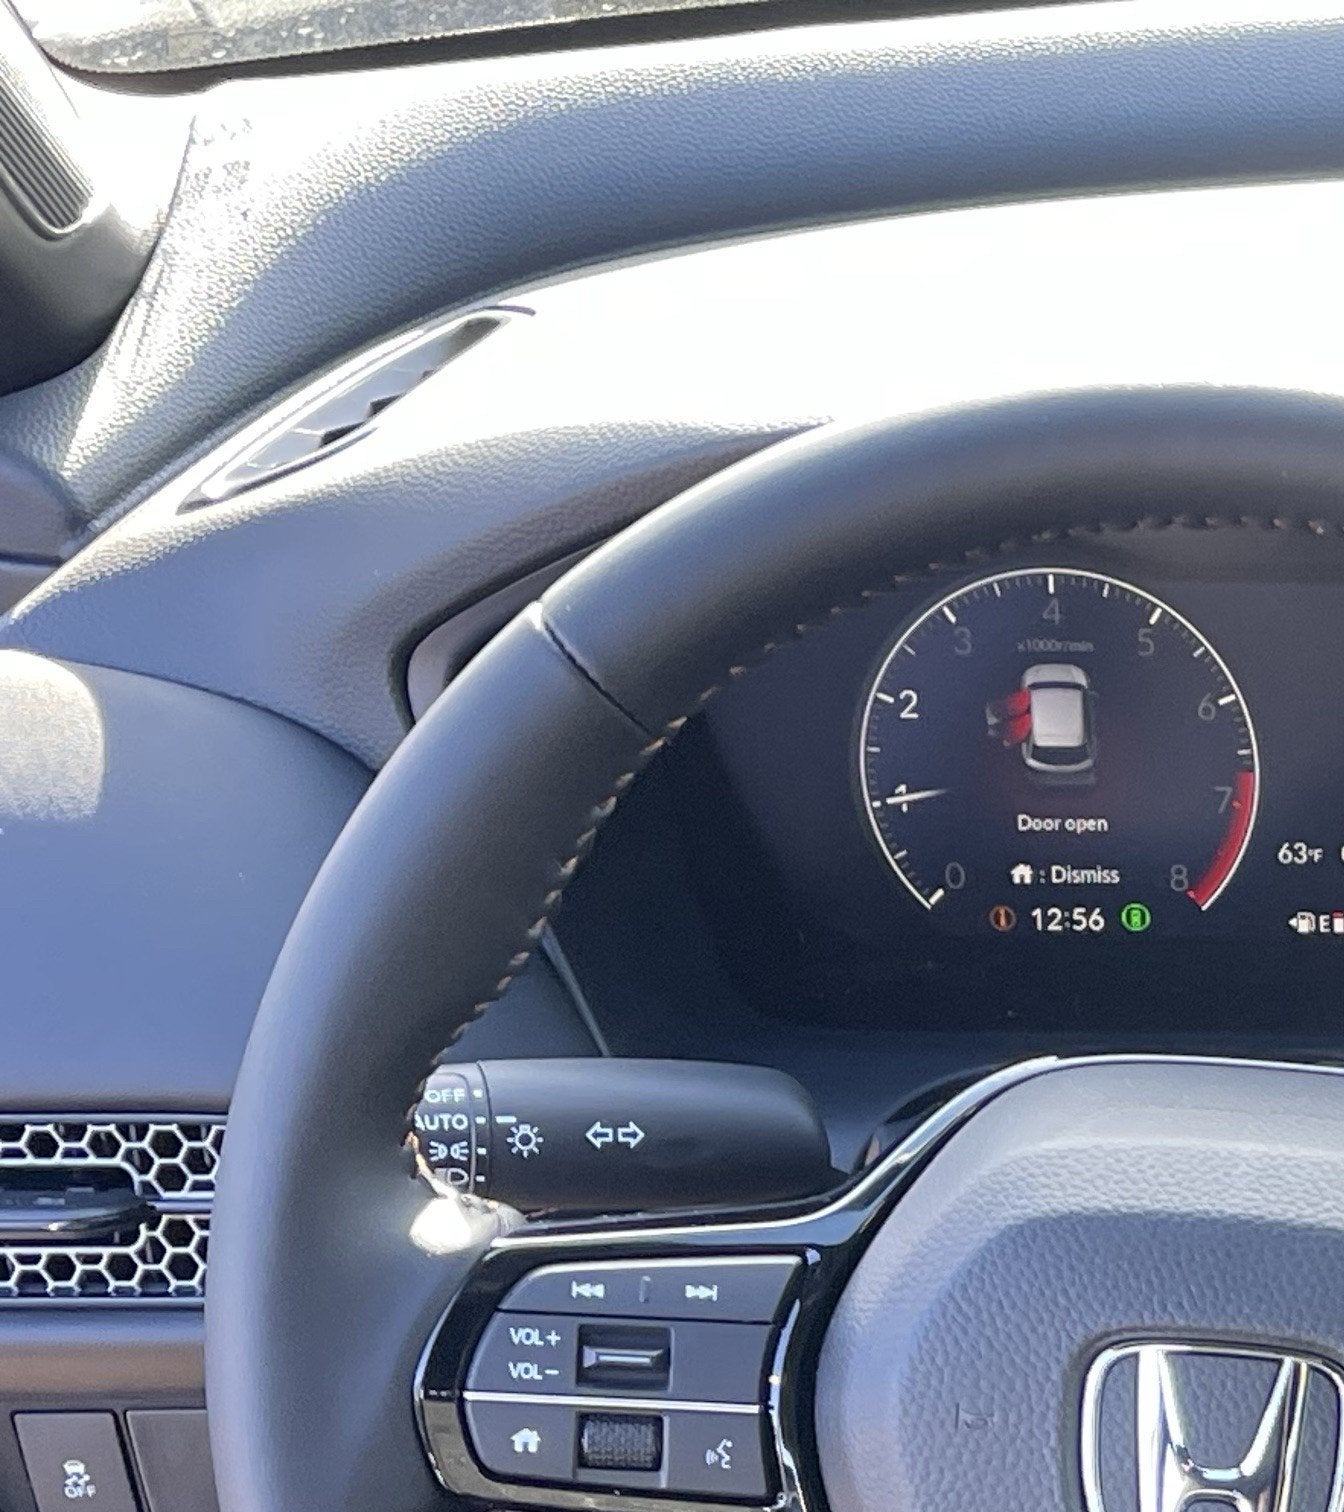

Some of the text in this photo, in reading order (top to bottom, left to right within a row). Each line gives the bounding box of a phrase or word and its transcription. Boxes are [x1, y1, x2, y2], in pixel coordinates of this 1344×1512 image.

[1042, 600, 1062, 624] 4
[954, 629, 973, 655] 3
[1137, 629, 1156, 656] 5
[899, 689, 919, 718] 2
[1197, 697, 1216, 720] 6
[1215, 786, 1233, 814] 7
[1017, 814, 1109, 836] Door open
[946, 861, 966, 888] 0
[1051, 865, 1120, 885] Dismiss
[1170, 865, 1189, 892] 8
[1031, 907, 1105, 931] 12:56
[1319, 914, 1331, 933] E
[424, 1088, 465, 1103] OFF
[414, 1111, 469, 1131] AUTO
